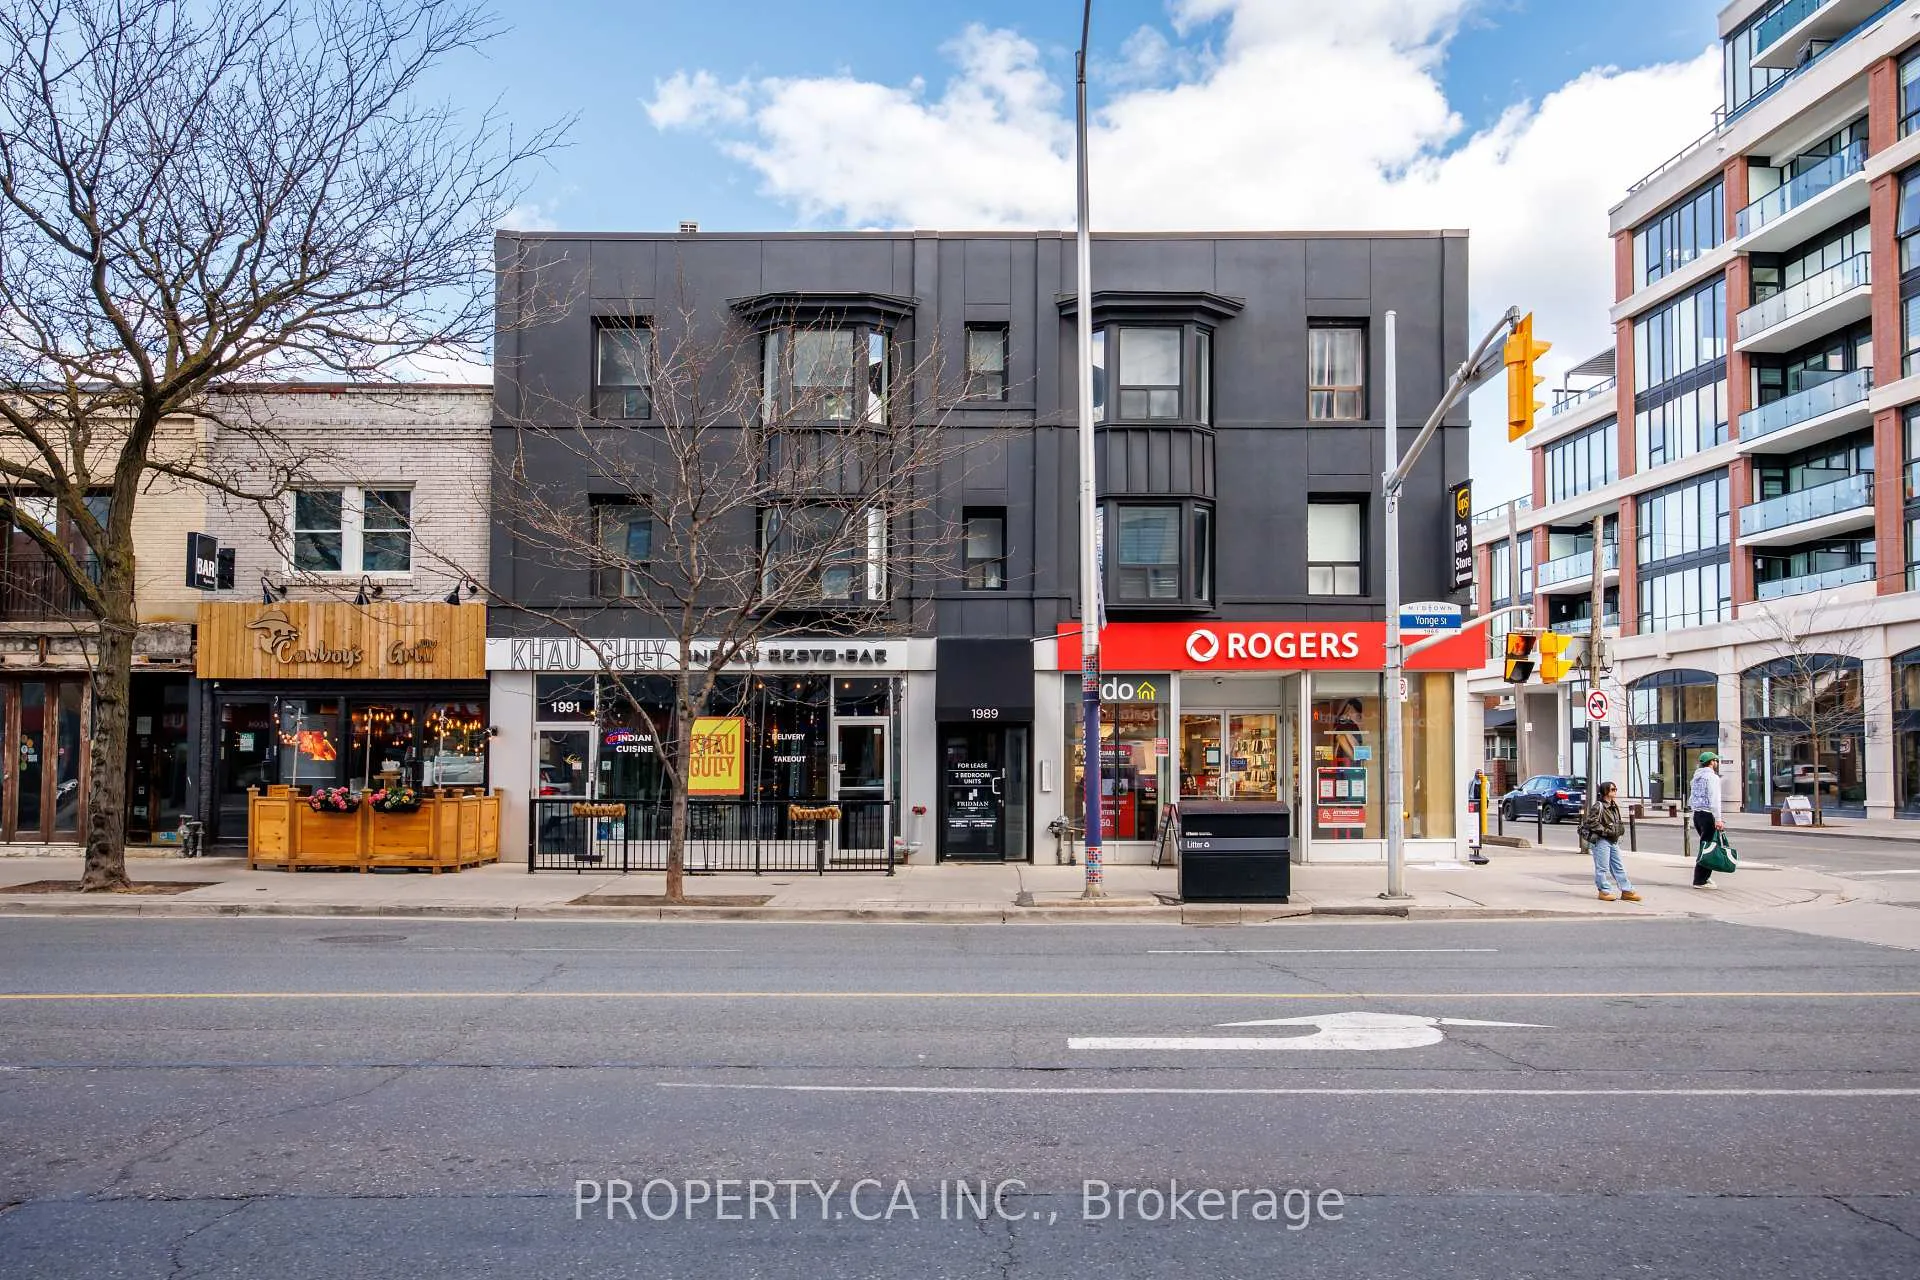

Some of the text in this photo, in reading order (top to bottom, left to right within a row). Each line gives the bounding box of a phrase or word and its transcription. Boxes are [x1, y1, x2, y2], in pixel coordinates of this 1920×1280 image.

[1455, 524, 1467, 537] The
[1455, 539, 1468, 553] UPS
[197, 557, 215, 578] BAR
[1455, 556, 1471, 570] Store
[1415, 615, 1447, 627] Yonge St
[1227, 632, 1360, 659] ROGERS
[276, 640, 364, 670] Cowboy's
[511, 639, 667, 670] KHAU GULLY
[551, 701, 581, 713] 1991
[971, 708, 999, 719] 1989
[617, 734, 652, 742] INDIAN
[771, 733, 806, 741] DELIVERY
[616, 745, 654, 753] CUISINE
[690, 733, 735, 755] KHAU
[773, 755, 807, 763] TAKEOUT
[1187, 840, 1203, 849] Litter
